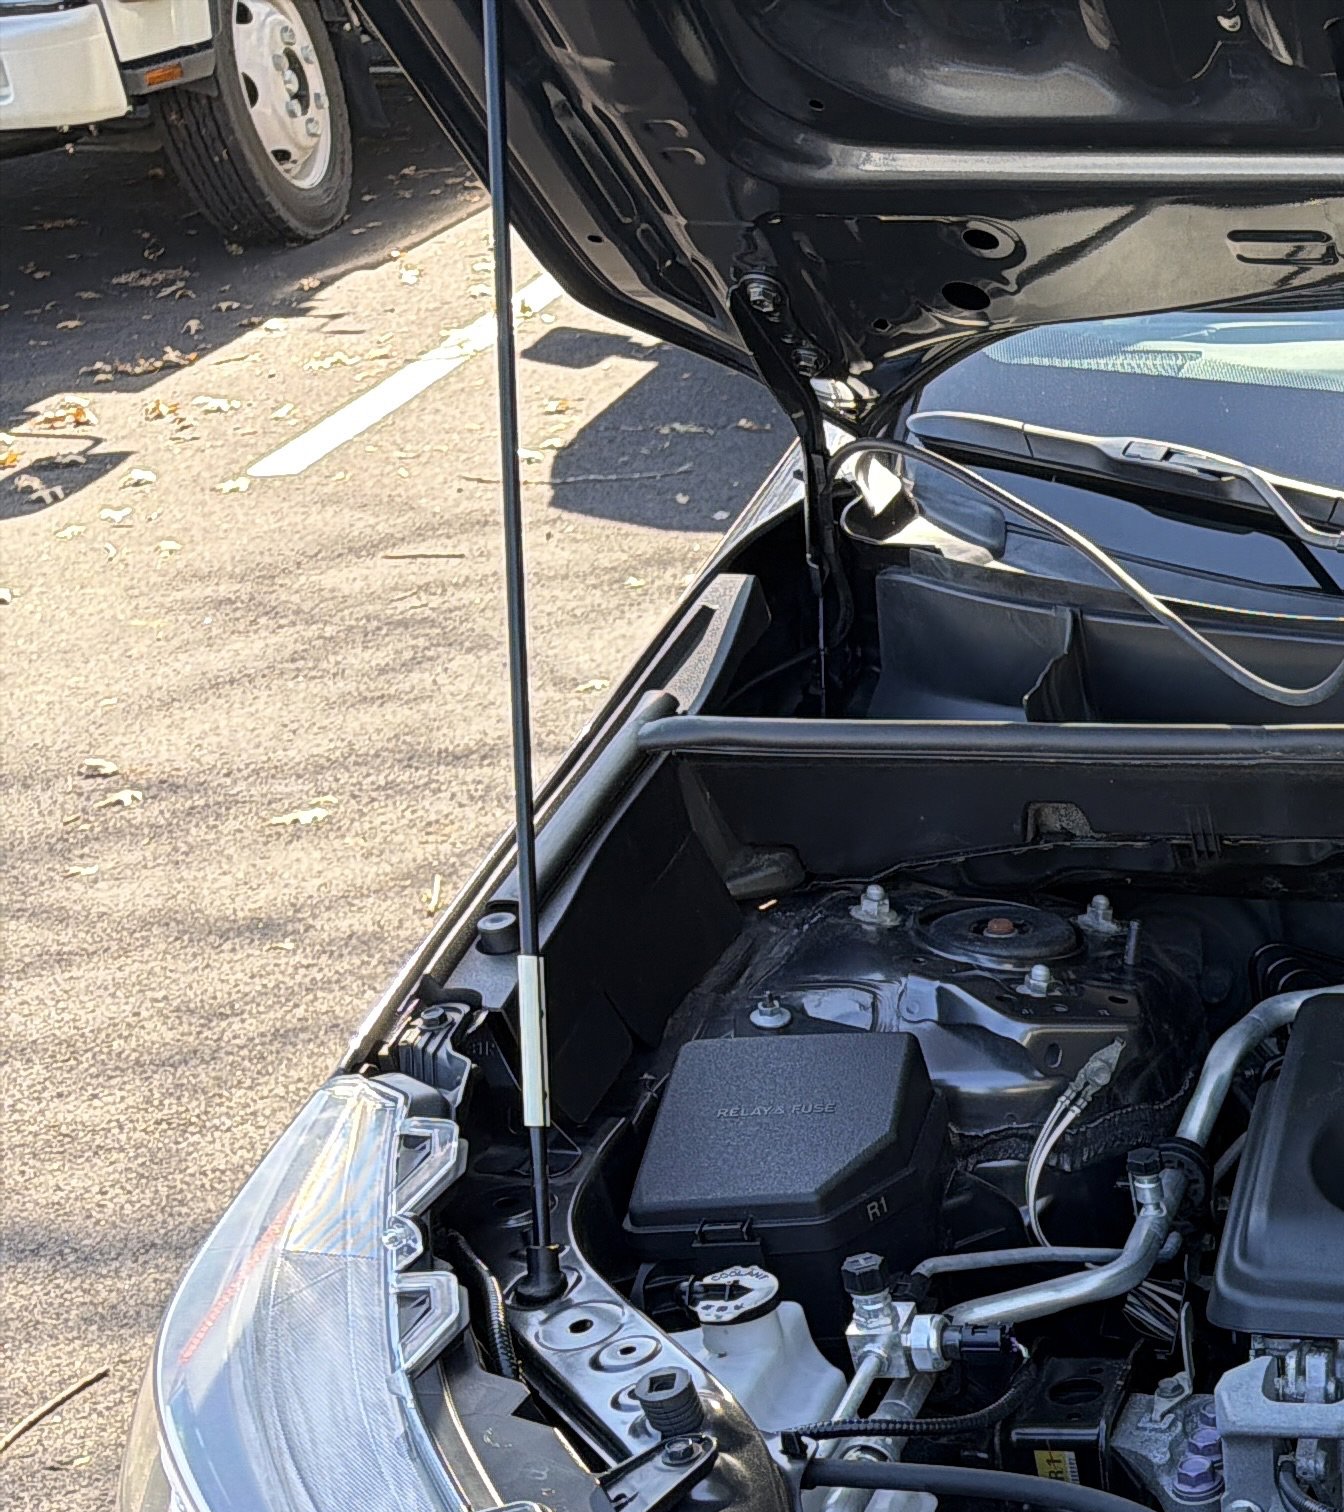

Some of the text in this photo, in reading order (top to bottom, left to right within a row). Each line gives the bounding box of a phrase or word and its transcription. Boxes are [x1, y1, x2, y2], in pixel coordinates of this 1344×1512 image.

[717, 1105, 773, 1119] RELAY
[792, 1103, 837, 1114] FUSE
[866, 1196, 888, 1221] R1
[711, 1268, 769, 1281] COOLANT
